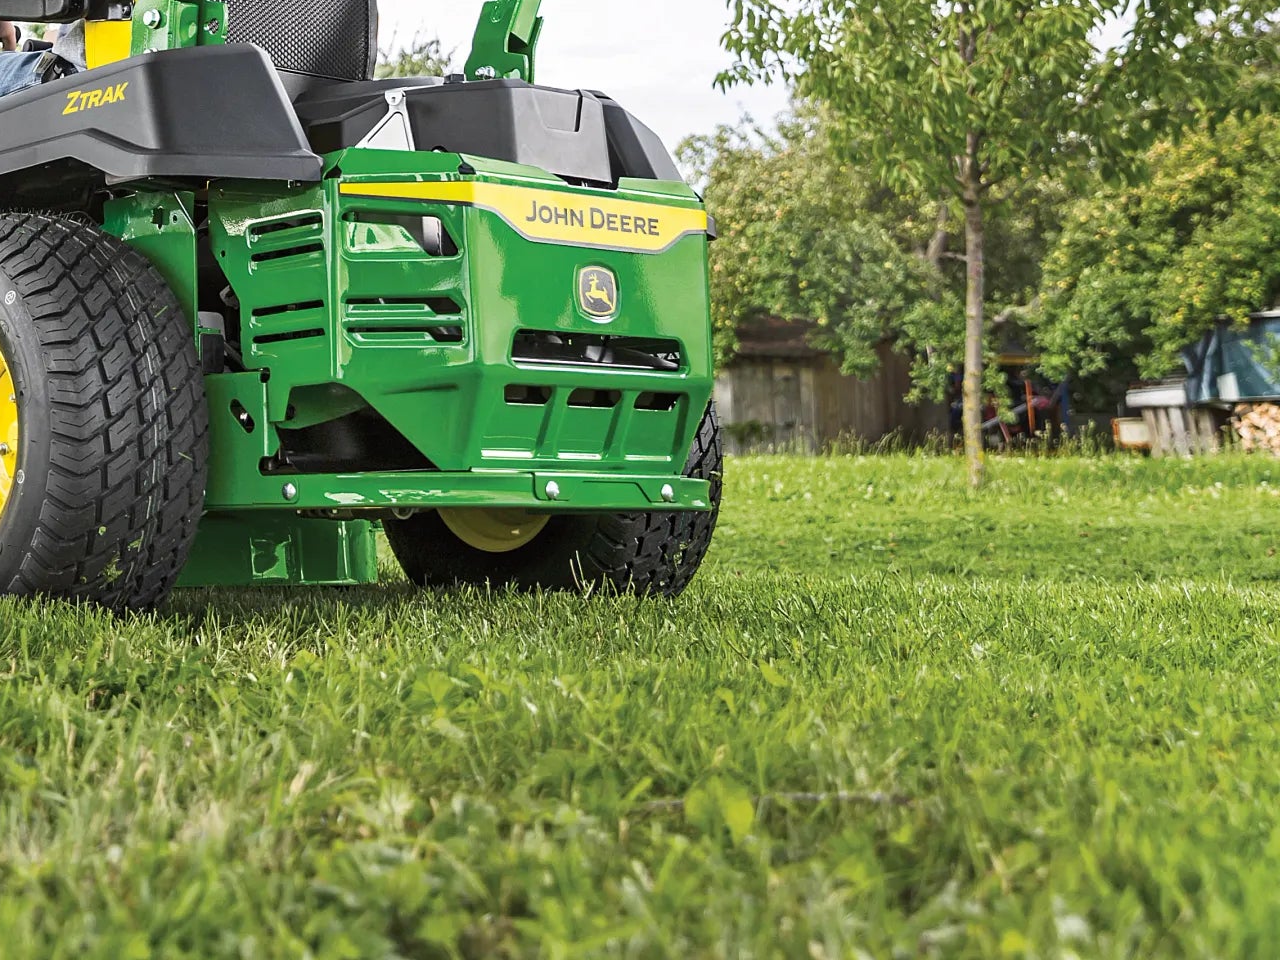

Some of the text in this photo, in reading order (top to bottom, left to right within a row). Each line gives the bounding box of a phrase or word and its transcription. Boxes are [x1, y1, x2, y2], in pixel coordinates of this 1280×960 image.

[62, 81, 129, 115] ZTRAK
[525, 200, 660, 236] JOHN DEERE
